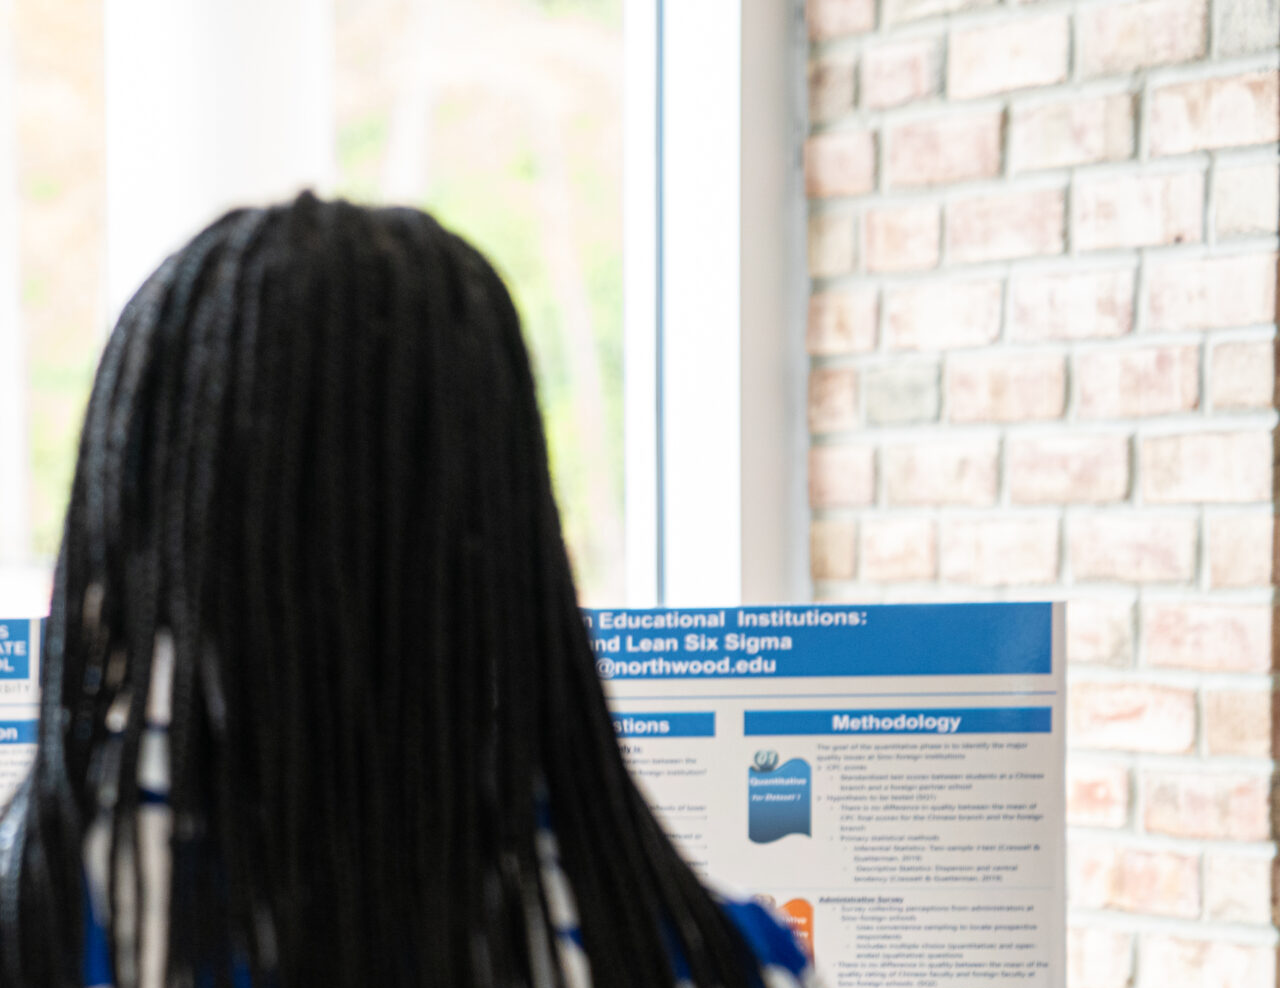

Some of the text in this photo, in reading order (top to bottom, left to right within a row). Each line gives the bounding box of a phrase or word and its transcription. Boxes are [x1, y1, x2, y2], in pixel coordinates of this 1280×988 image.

[599, 611, 725, 629] Educational
[737, 608, 868, 627] Institutions:
[591, 632, 792, 655] nd Lean Six Sigma
[596, 656, 776, 679] @northwood.edu
[832, 714, 961, 733] Methodology
[750, 777, 807, 787] Quantitative
